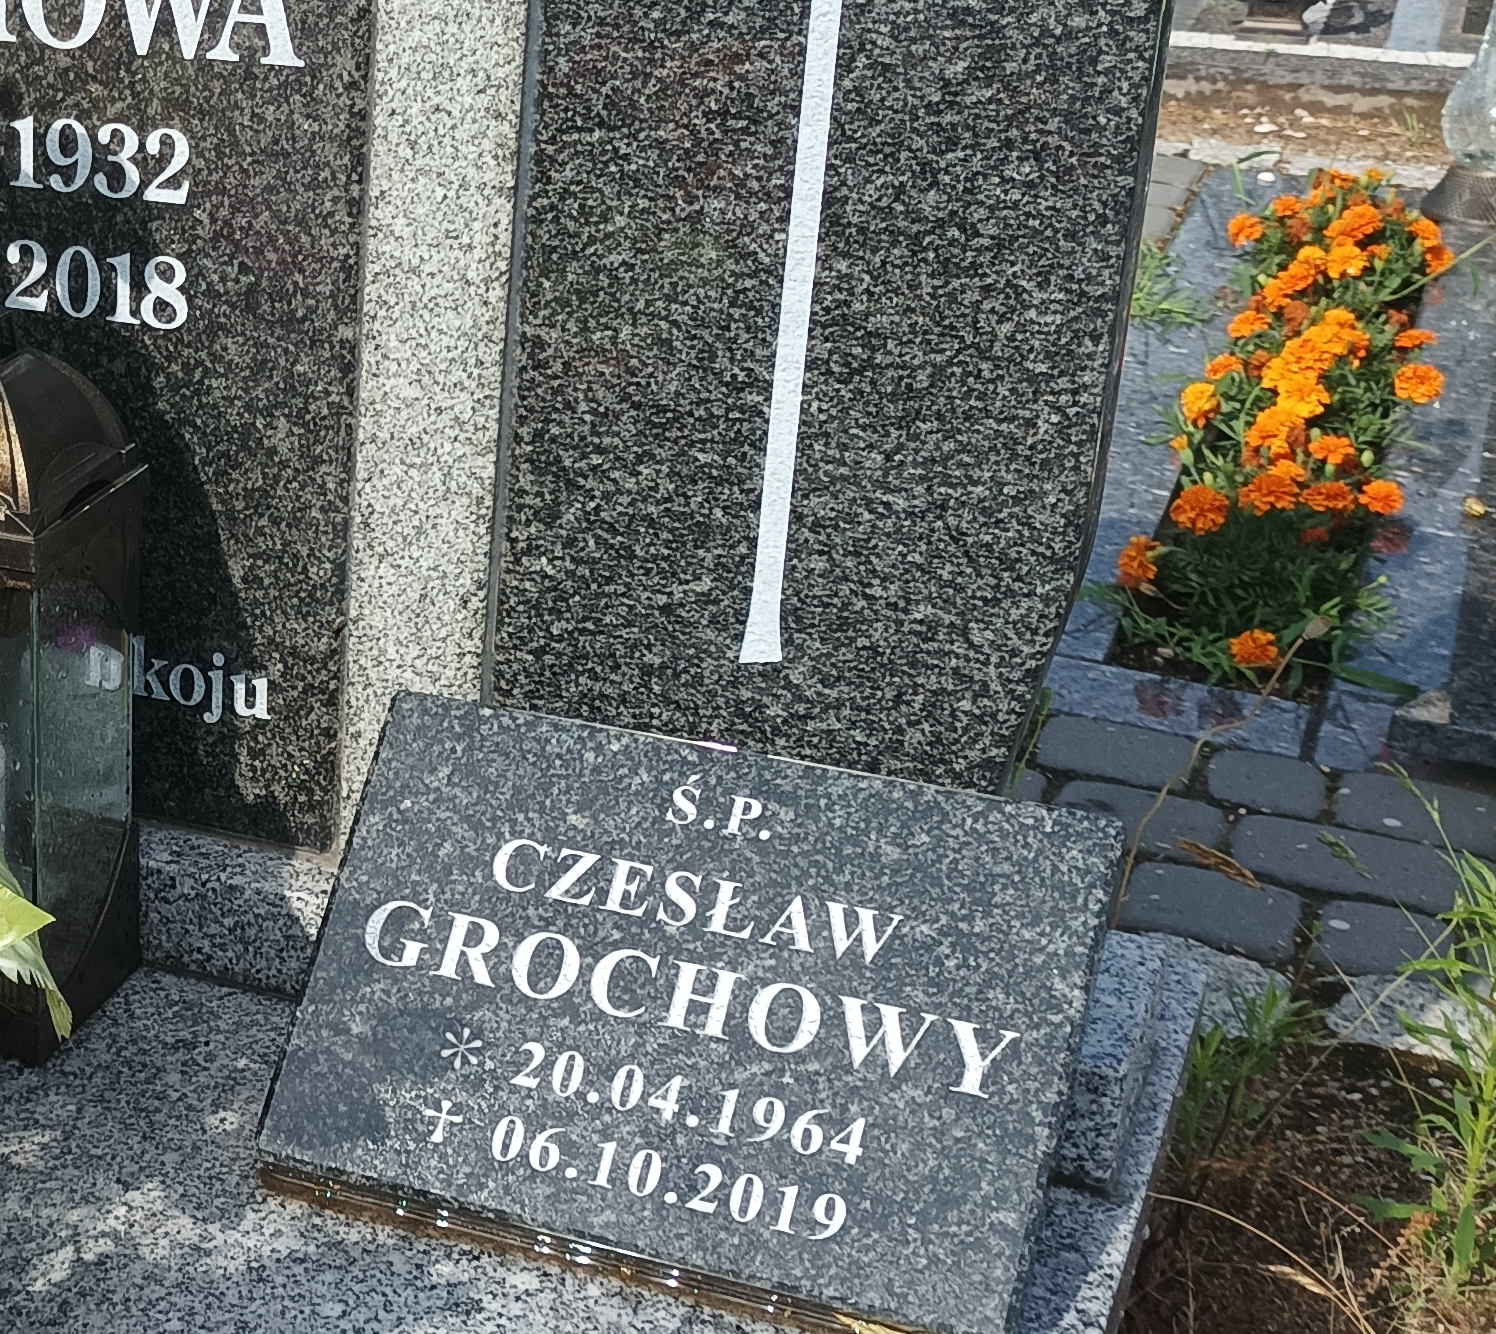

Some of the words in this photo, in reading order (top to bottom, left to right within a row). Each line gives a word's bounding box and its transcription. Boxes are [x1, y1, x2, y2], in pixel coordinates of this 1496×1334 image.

[666, 774, 772, 841] Ś.P.
[492, 838, 904, 965] CZESŁAW
[364, 899, 1021, 1099] GROCHOWY
[509, 1040, 867, 1166] 20.04.1964
[491, 1114, 848, 1241] 06.10.2019
